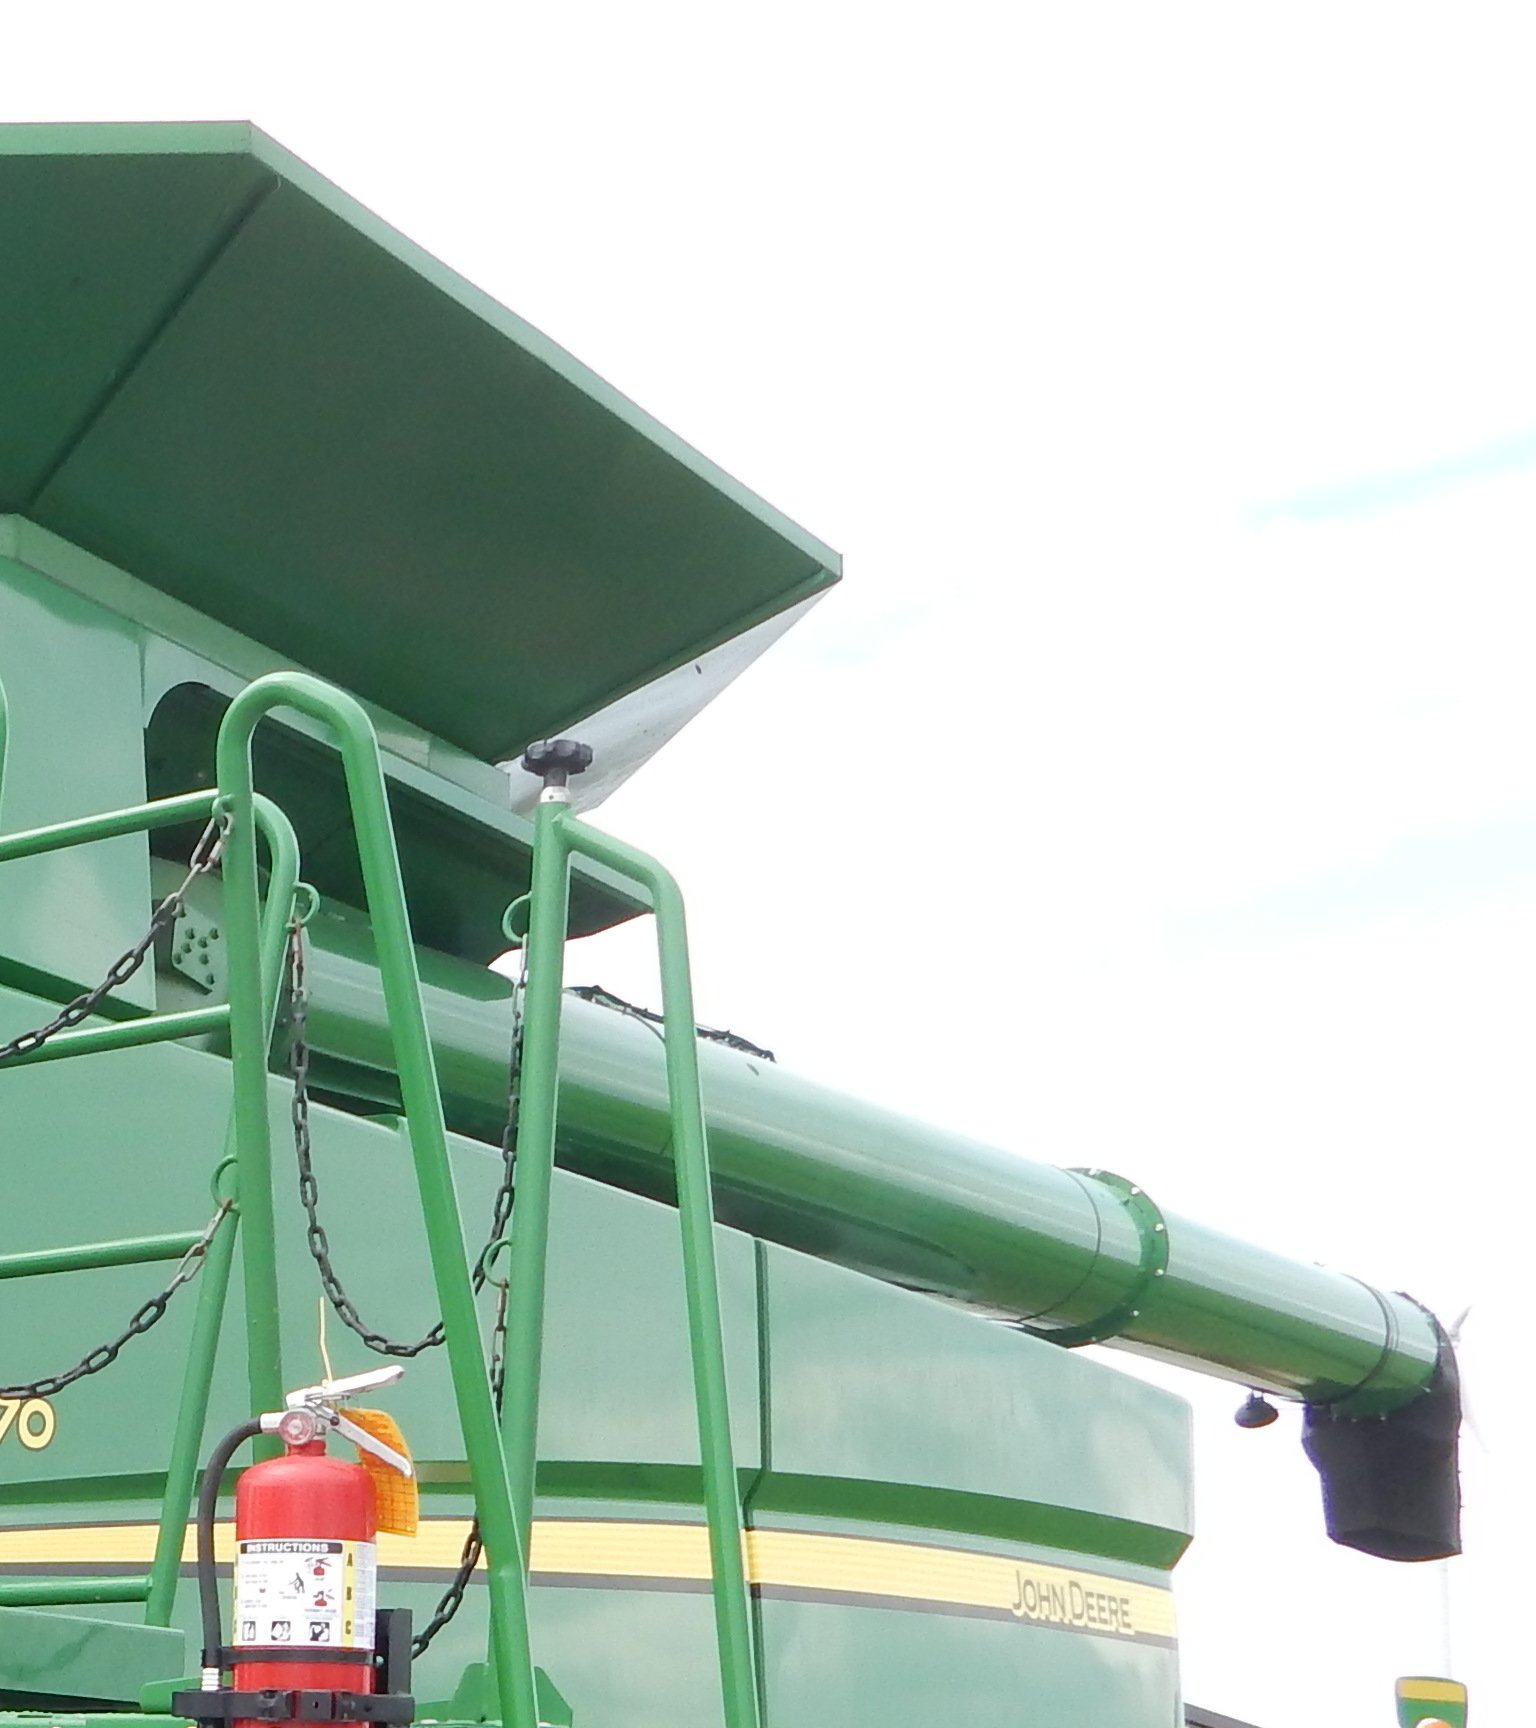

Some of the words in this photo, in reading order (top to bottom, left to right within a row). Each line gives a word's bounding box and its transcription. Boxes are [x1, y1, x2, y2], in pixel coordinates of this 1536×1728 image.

[246, 1543, 329, 1553] INSTRUCTIONS
[1012, 1570, 1066, 1618] JOHN
[1068, 1580, 1133, 1630] DEERE
